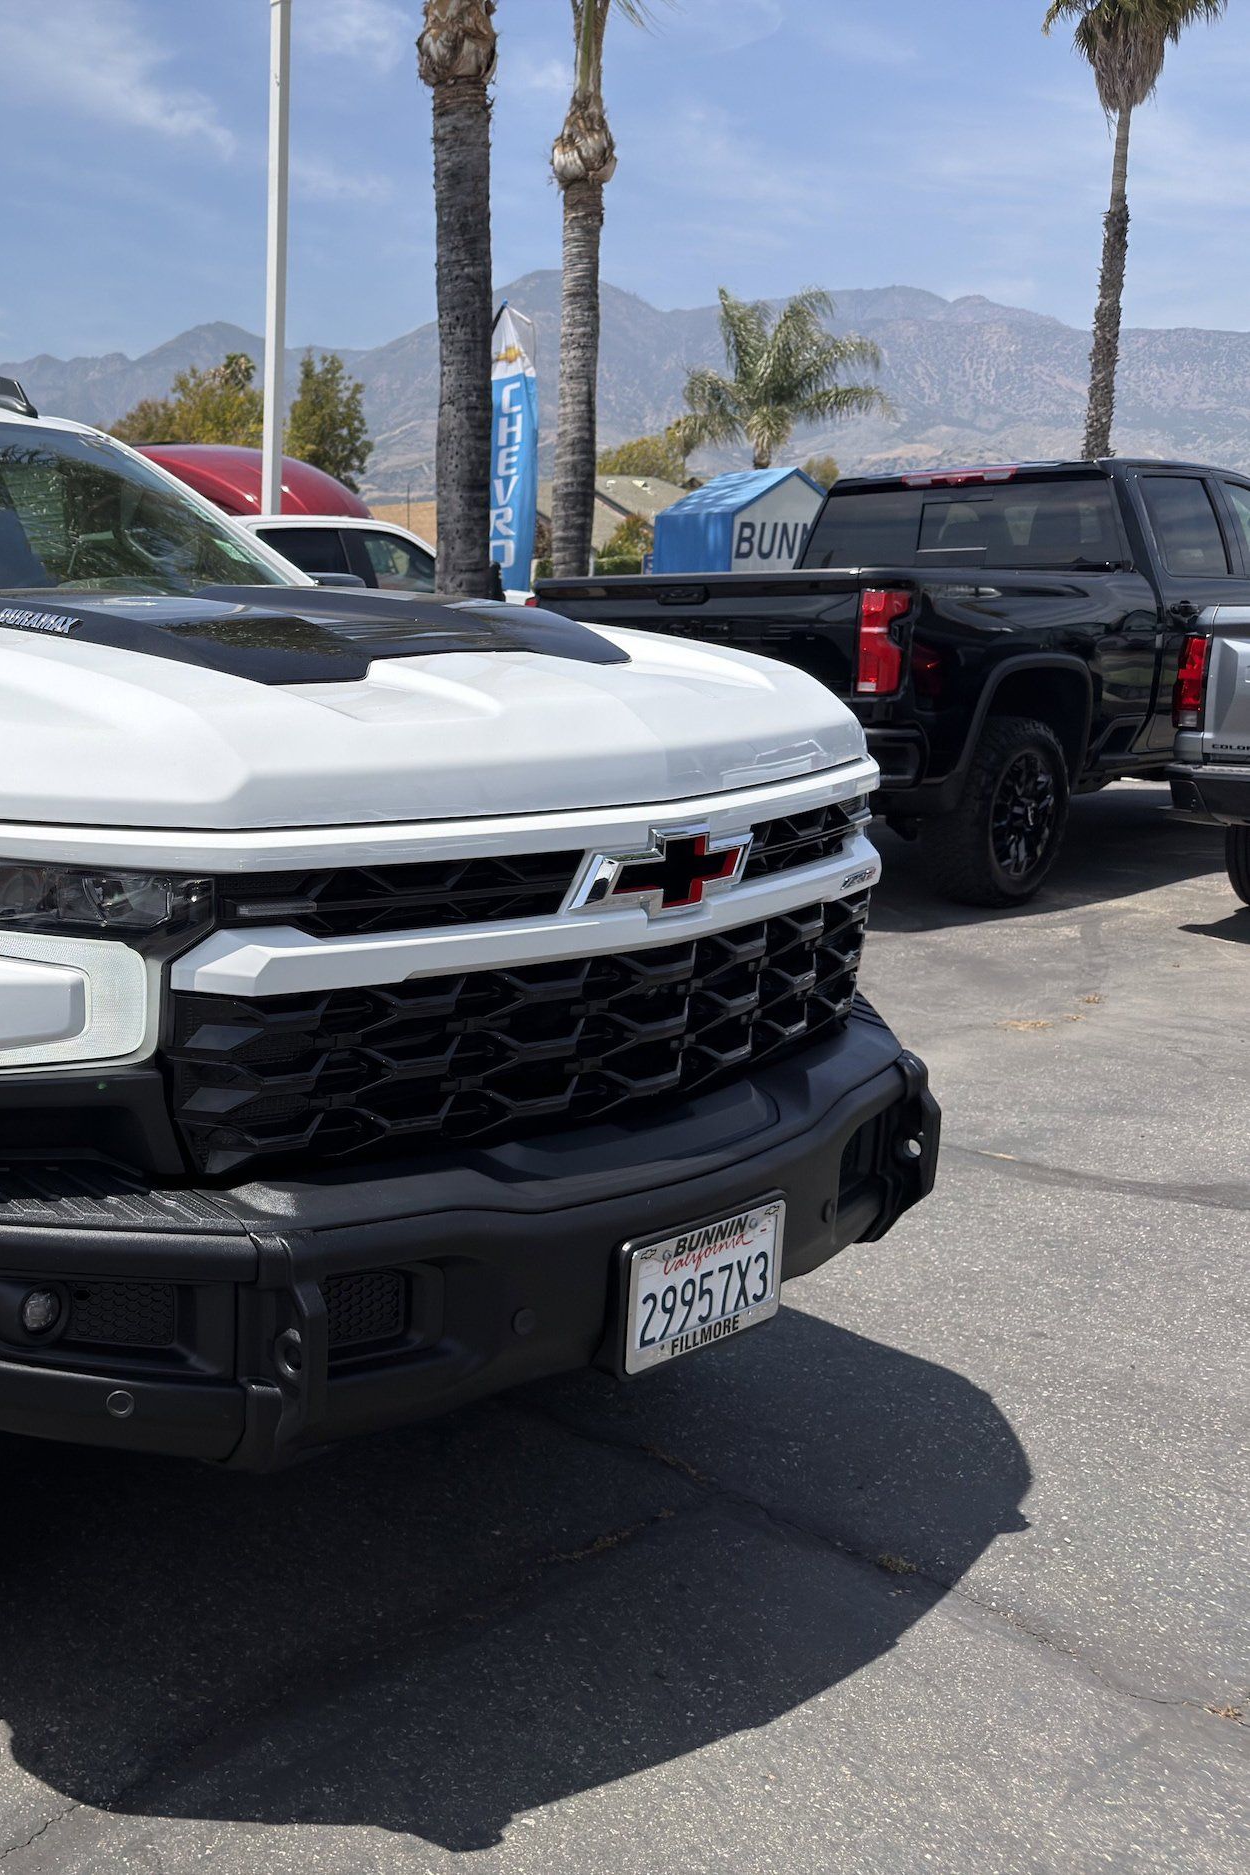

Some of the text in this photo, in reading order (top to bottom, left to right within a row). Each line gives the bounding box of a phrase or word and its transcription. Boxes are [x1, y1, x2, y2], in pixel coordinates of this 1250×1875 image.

[663, 1232, 754, 1276] California
[673, 1215, 749, 1258] BUNNIN
[639, 1251, 769, 1349] 29957X3
[671, 1314, 740, 1356] FILLMORE
